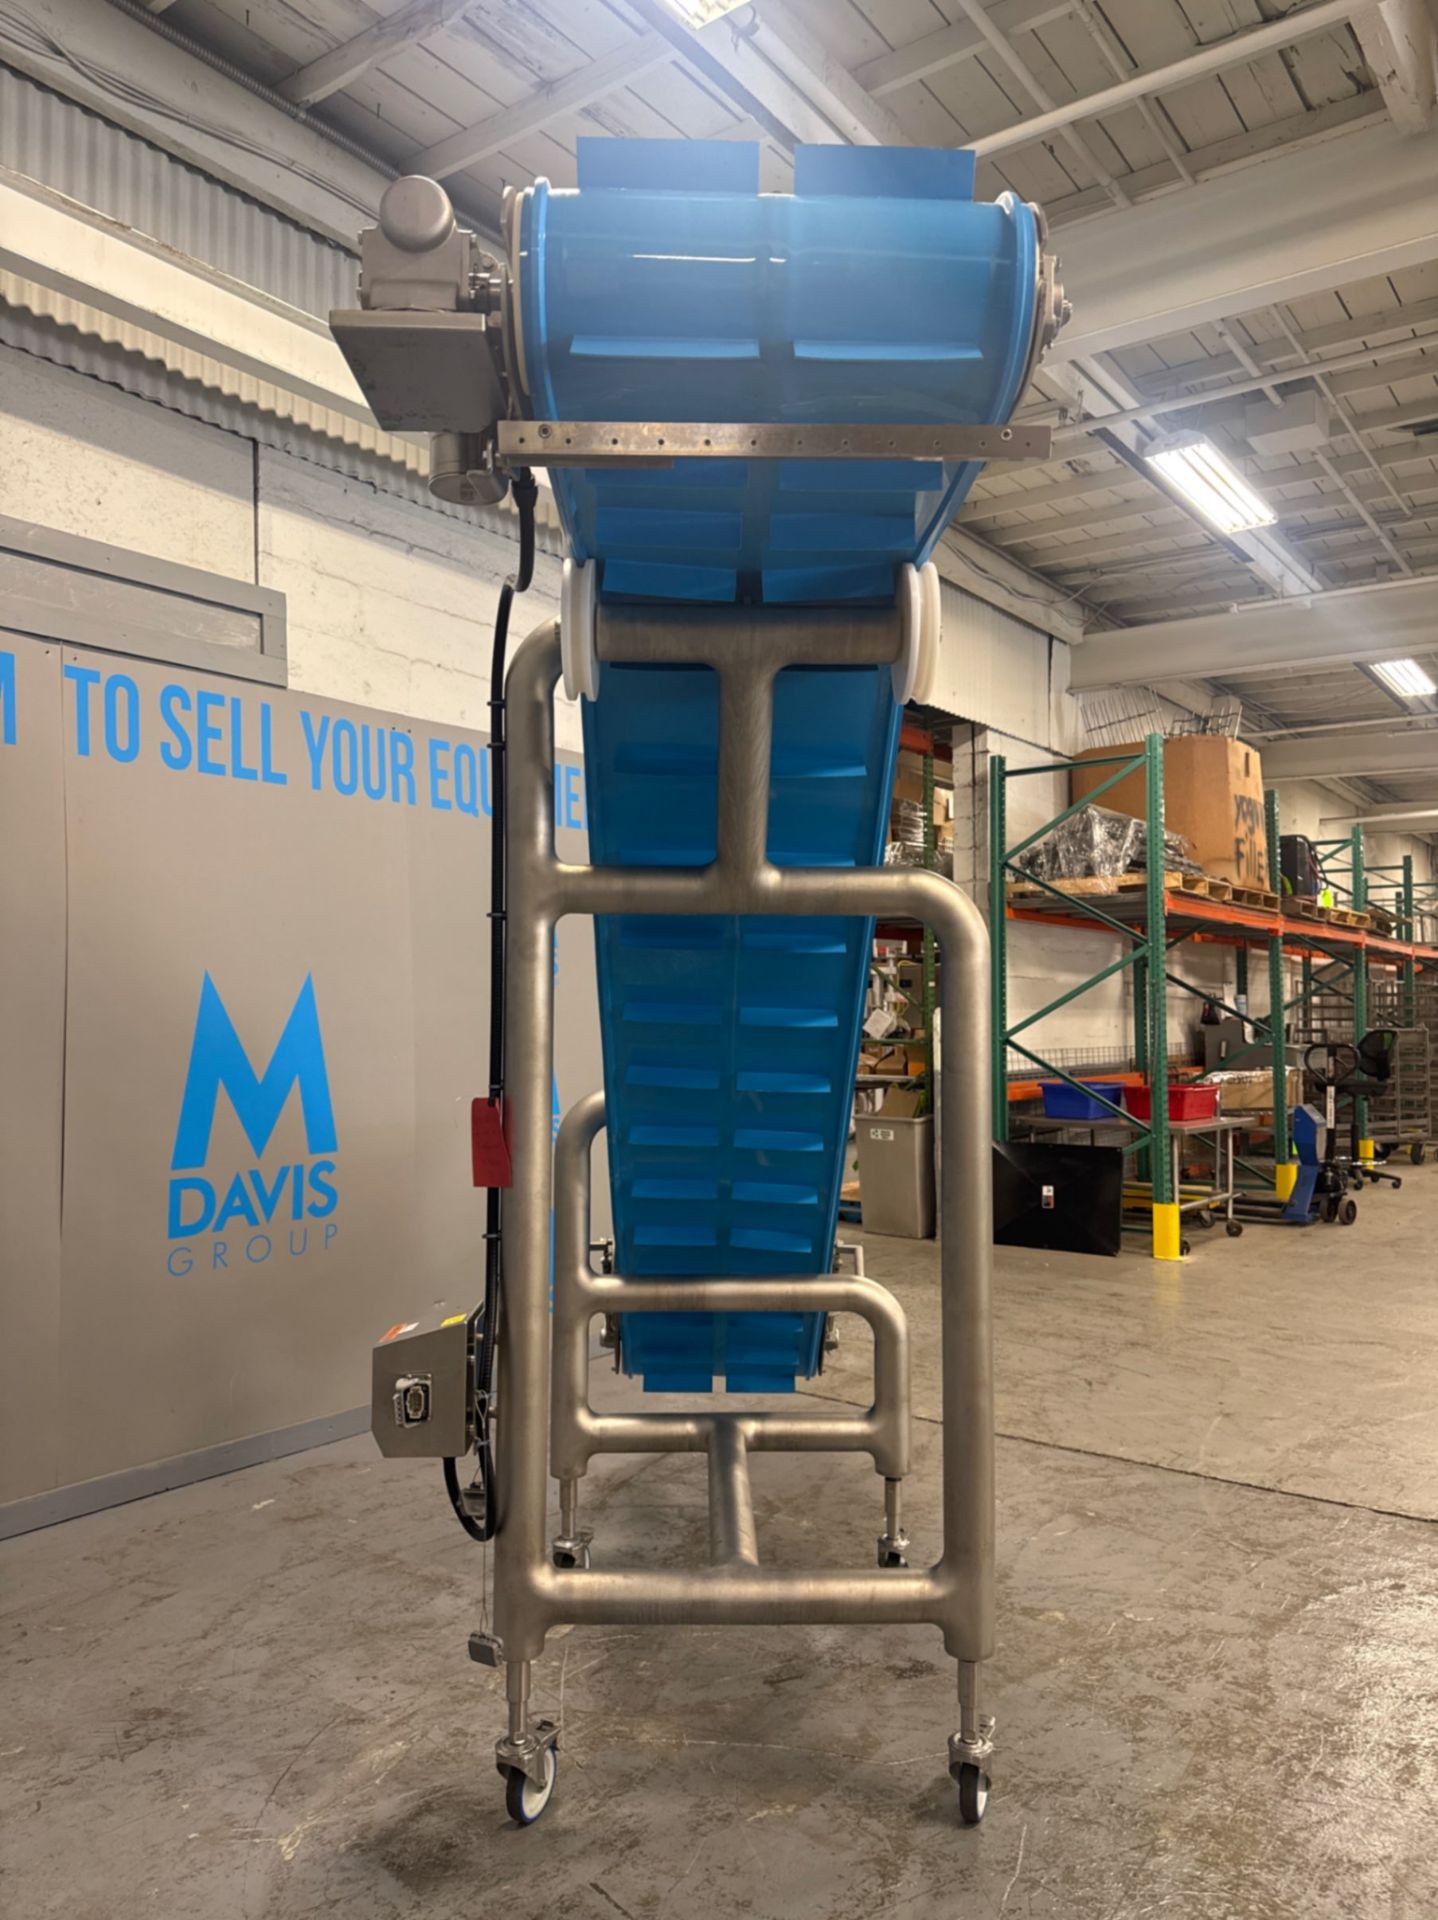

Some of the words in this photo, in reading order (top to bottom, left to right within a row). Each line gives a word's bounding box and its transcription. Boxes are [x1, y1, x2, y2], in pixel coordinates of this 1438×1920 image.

[63, 664, 140, 763] TO
[160, 684, 288, 785] SELL
[300, 711, 416, 805] YOUR
[170, 969, 338, 1171] M
[167, 1160, 339, 1240] DAVIS
[167, 1223, 338, 1277] GROUP
